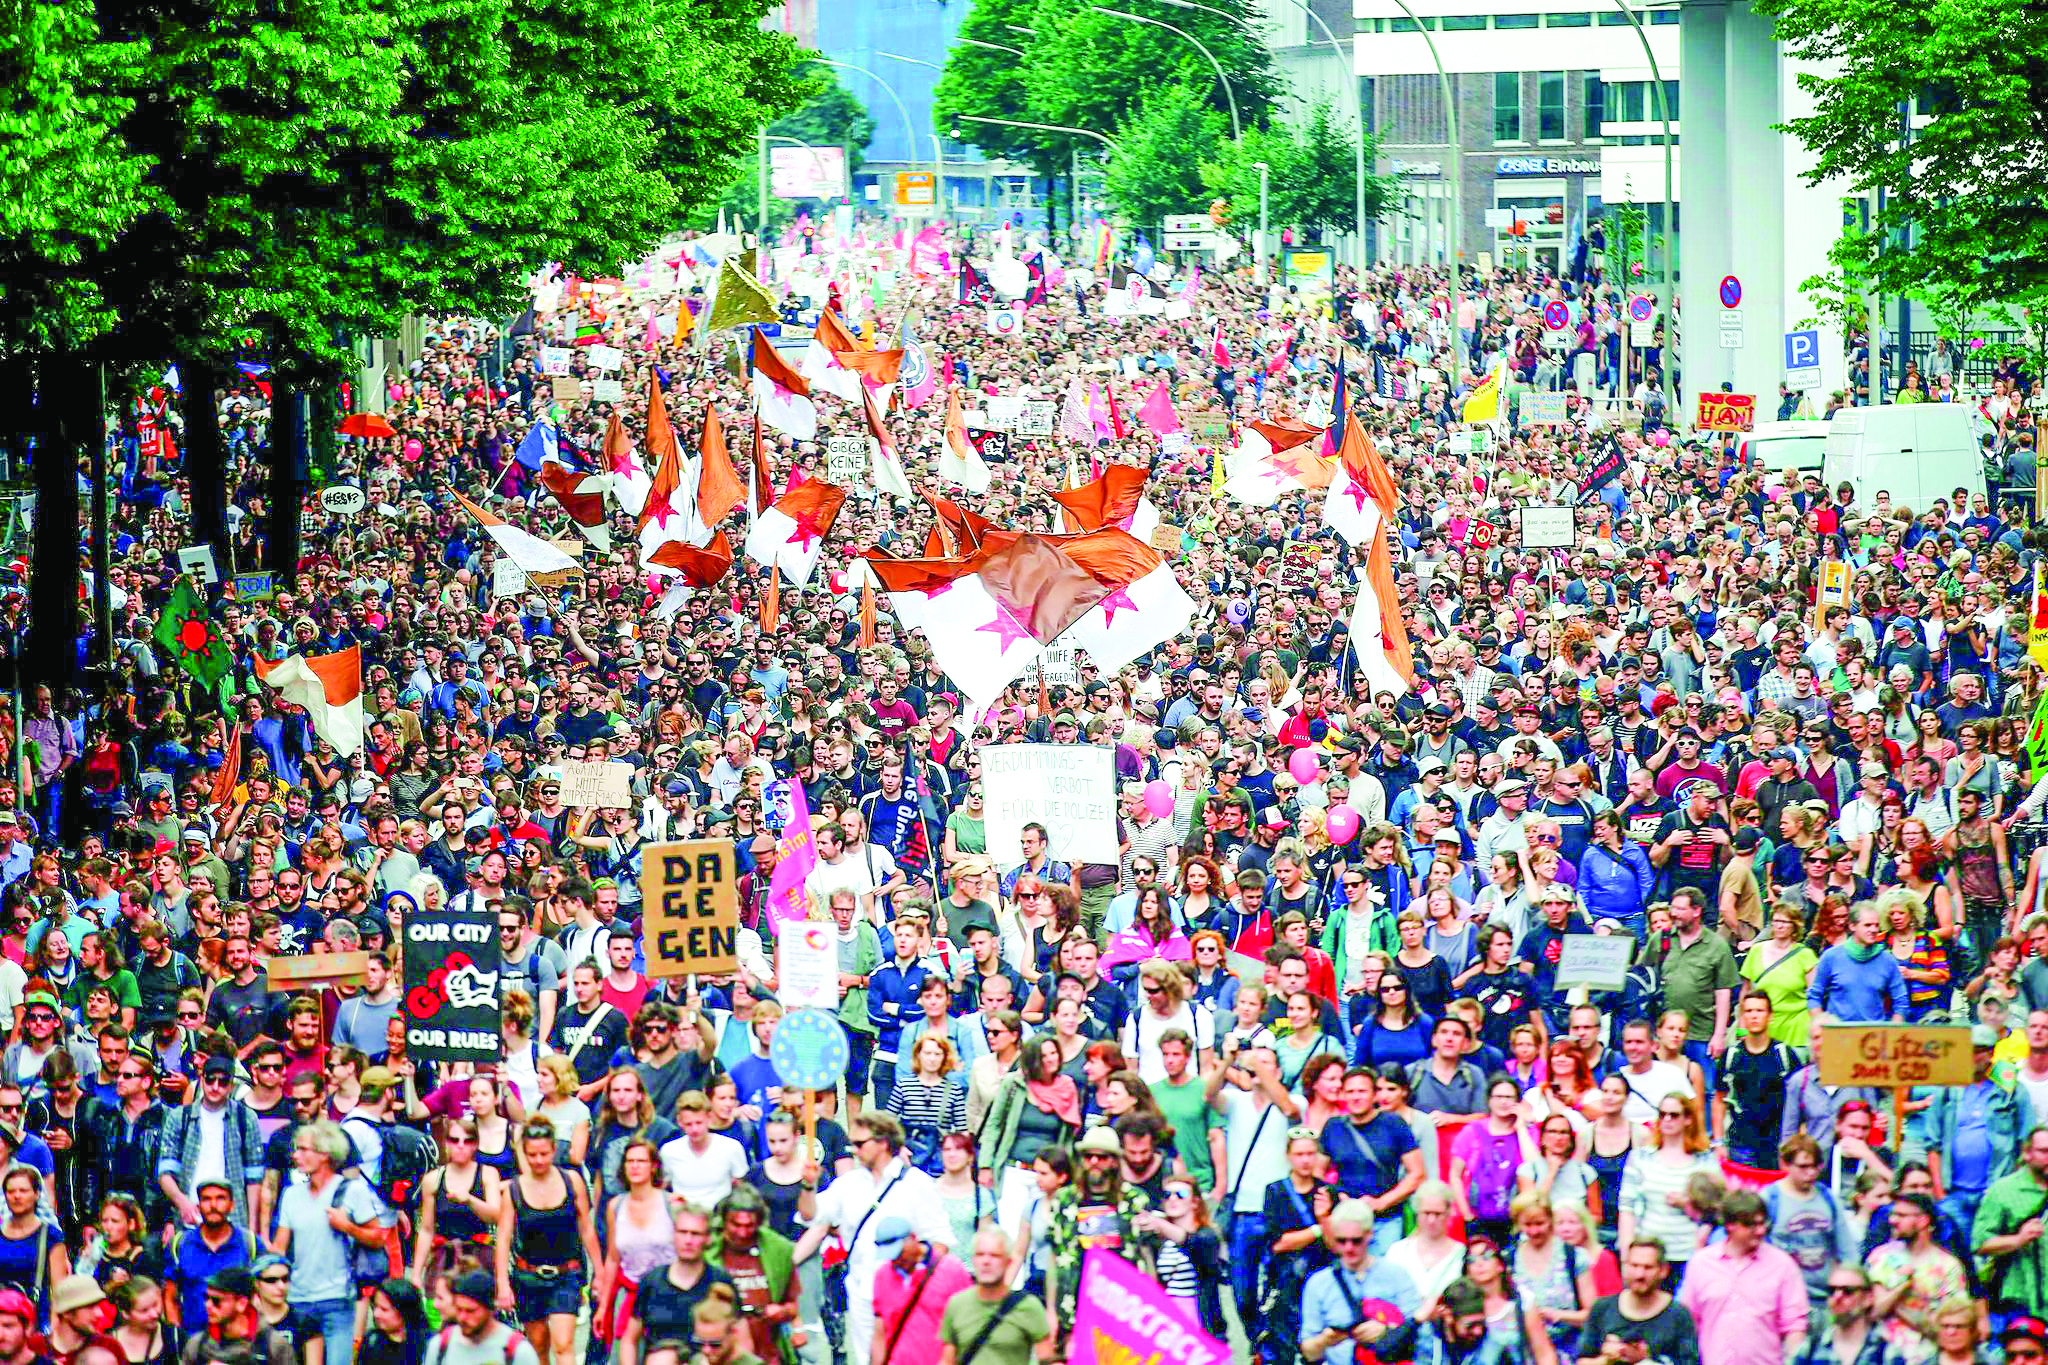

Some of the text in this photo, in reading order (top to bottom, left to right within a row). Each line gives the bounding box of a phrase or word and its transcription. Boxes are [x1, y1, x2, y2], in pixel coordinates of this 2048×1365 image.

[1792, 336, 1811, 365] P
[830, 441, 847, 453] GIB
[830, 455, 863, 469] KEINE
[567, 763, 613, 777] AGAINST
[576, 777, 606, 791] WHITE
[1047, 777, 1093, 796] VERBOT
[562, 789, 625, 806] SUPREMACY
[1002, 799, 1039, 820] FÜR
[1044, 800, 1061, 817] DIE
[663, 853, 722, 885] DA
[663, 887, 716, 919] GE
[409, 922, 493, 943] OUR CITY
[658, 926, 735, 963] GEN
[408, 1029, 498, 1050] OUR RULES
[1896, 1062, 1931, 1081] G20
